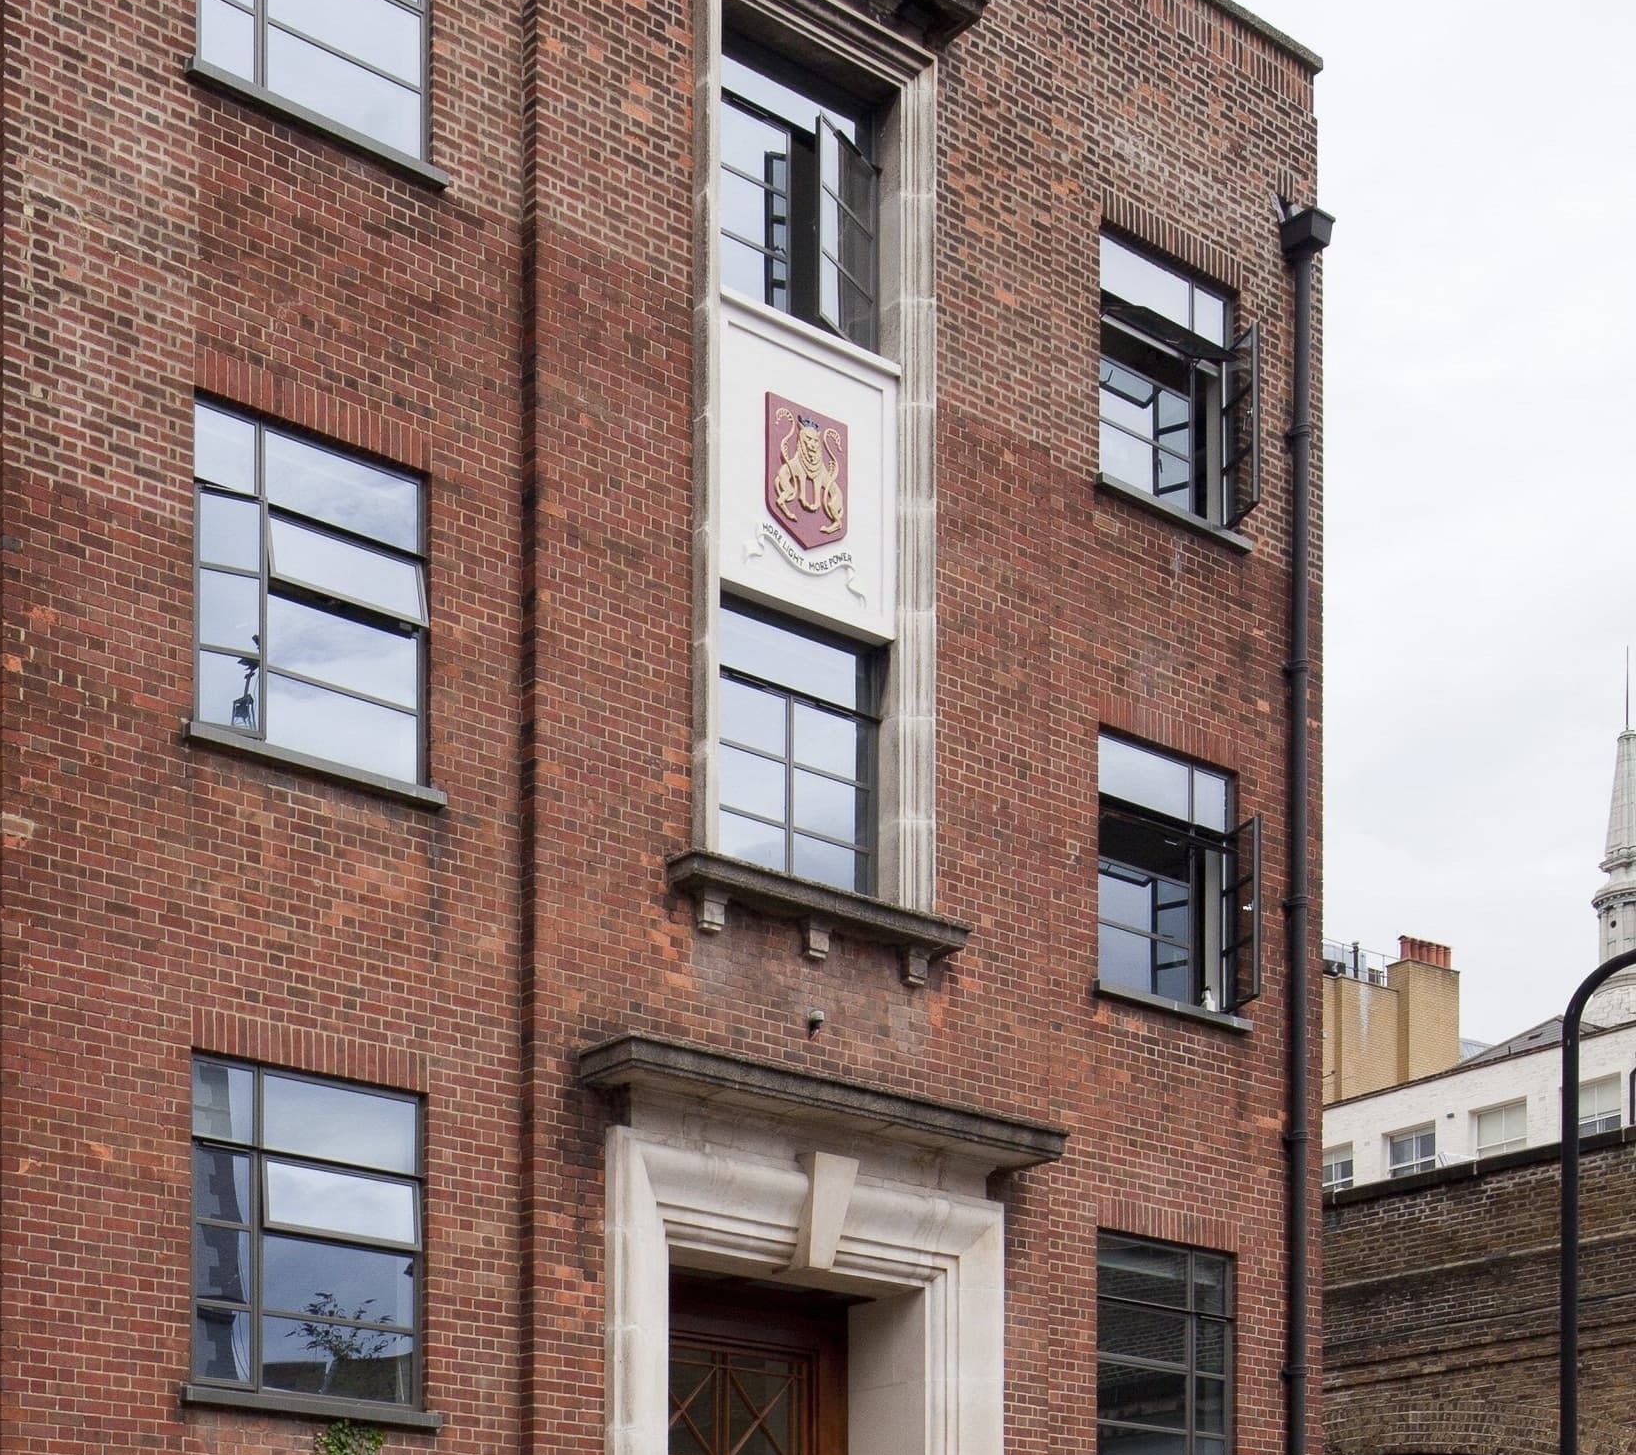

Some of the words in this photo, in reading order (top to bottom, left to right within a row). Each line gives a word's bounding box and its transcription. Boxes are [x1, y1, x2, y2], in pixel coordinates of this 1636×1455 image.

[763, 523, 782, 543] MORE
[783, 541, 804, 566] LIGHT
[809, 561, 828, 572] MORE
[829, 552, 852, 567] POWER
